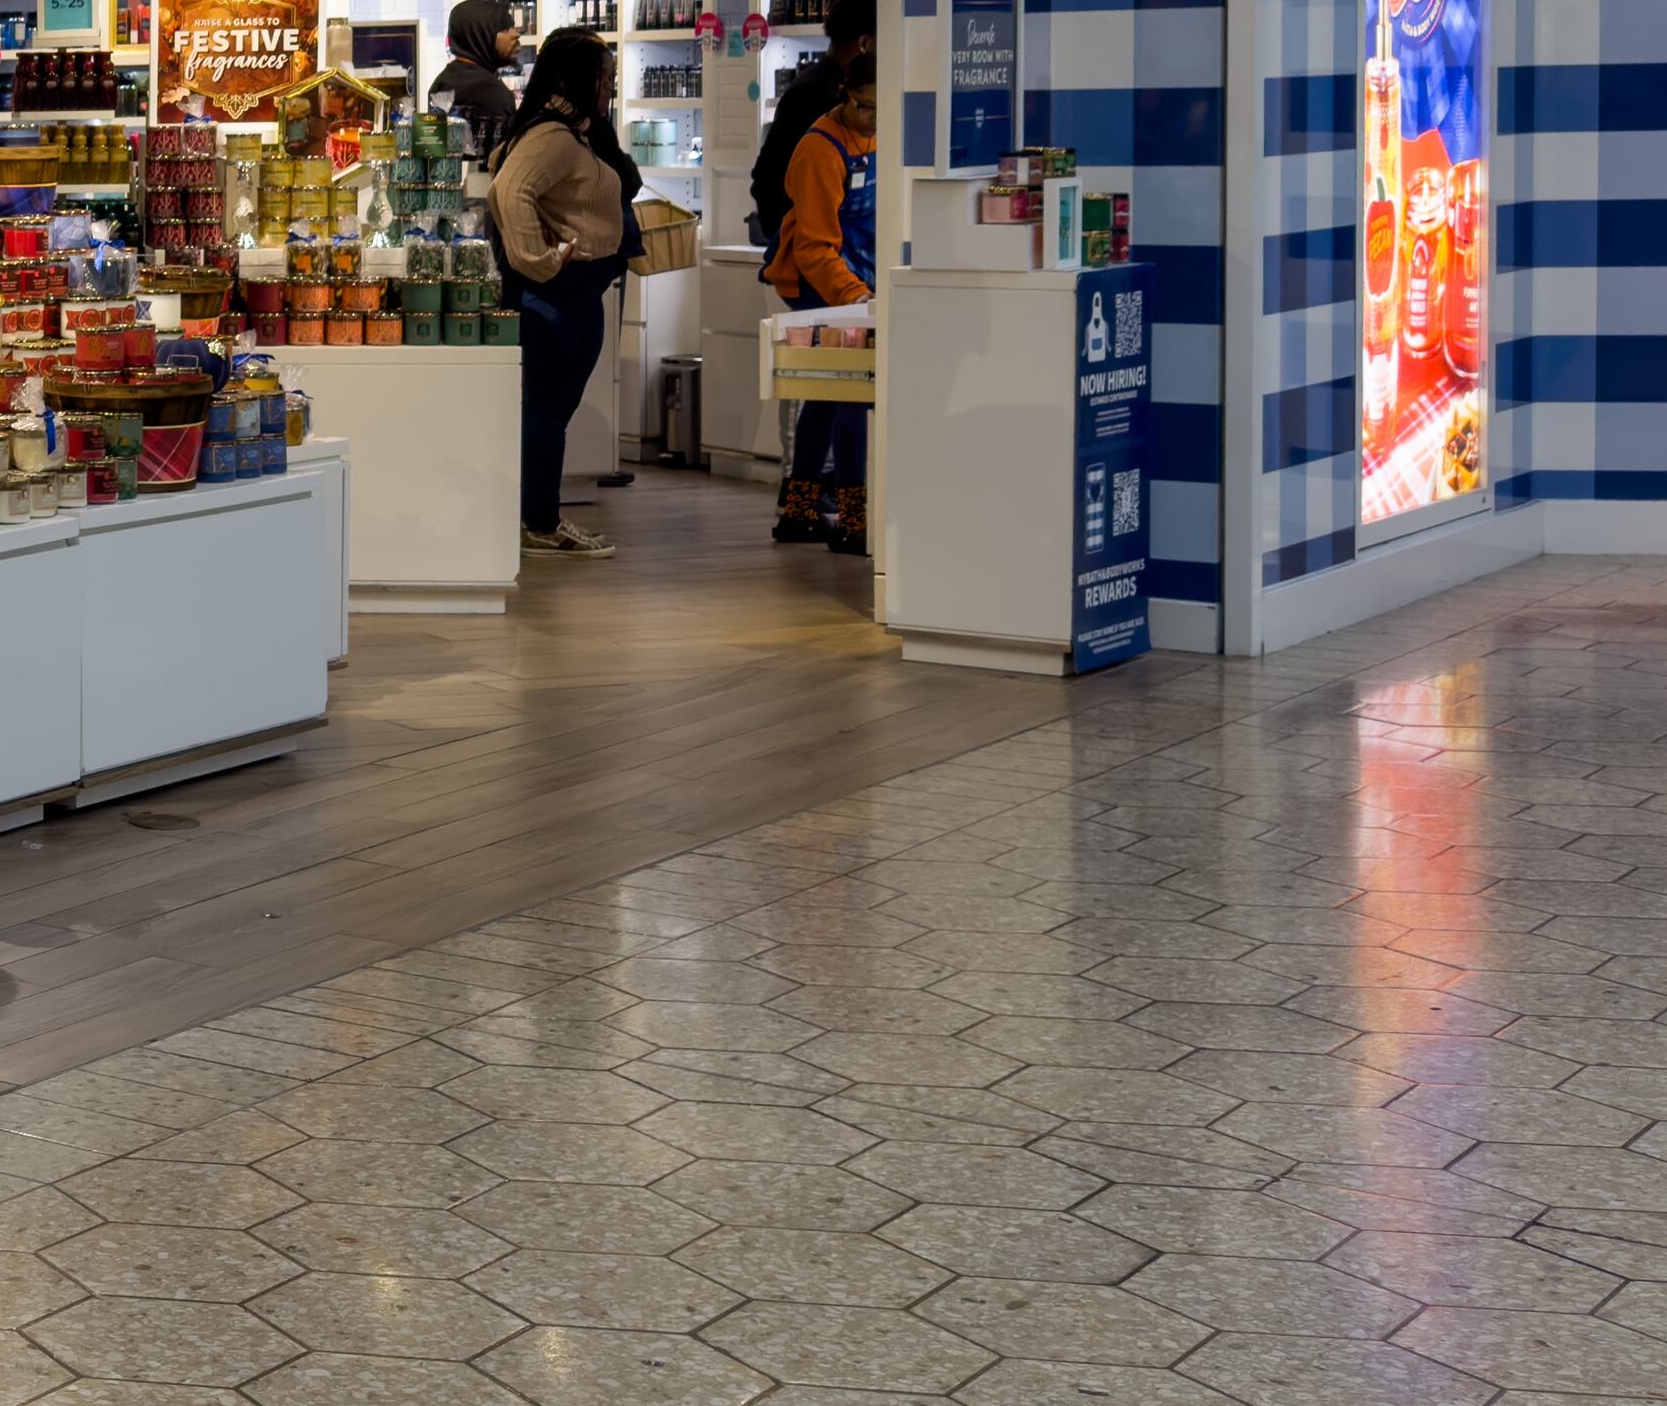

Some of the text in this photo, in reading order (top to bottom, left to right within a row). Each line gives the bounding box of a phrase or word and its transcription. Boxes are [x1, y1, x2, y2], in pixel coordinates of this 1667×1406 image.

[195, 17, 280, 27] RAISE A GLASS TO
[174, 28, 300, 53] FESTIVE
[185, 48, 288, 82] fragrances
[952, 49, 1014, 64] VERY ROOM WITH
[953, 68, 1008, 86] FRAGRANCE
[1080, 365, 1147, 397] NOW HIRING!
[1085, 576, 1137, 609] REWARDS
